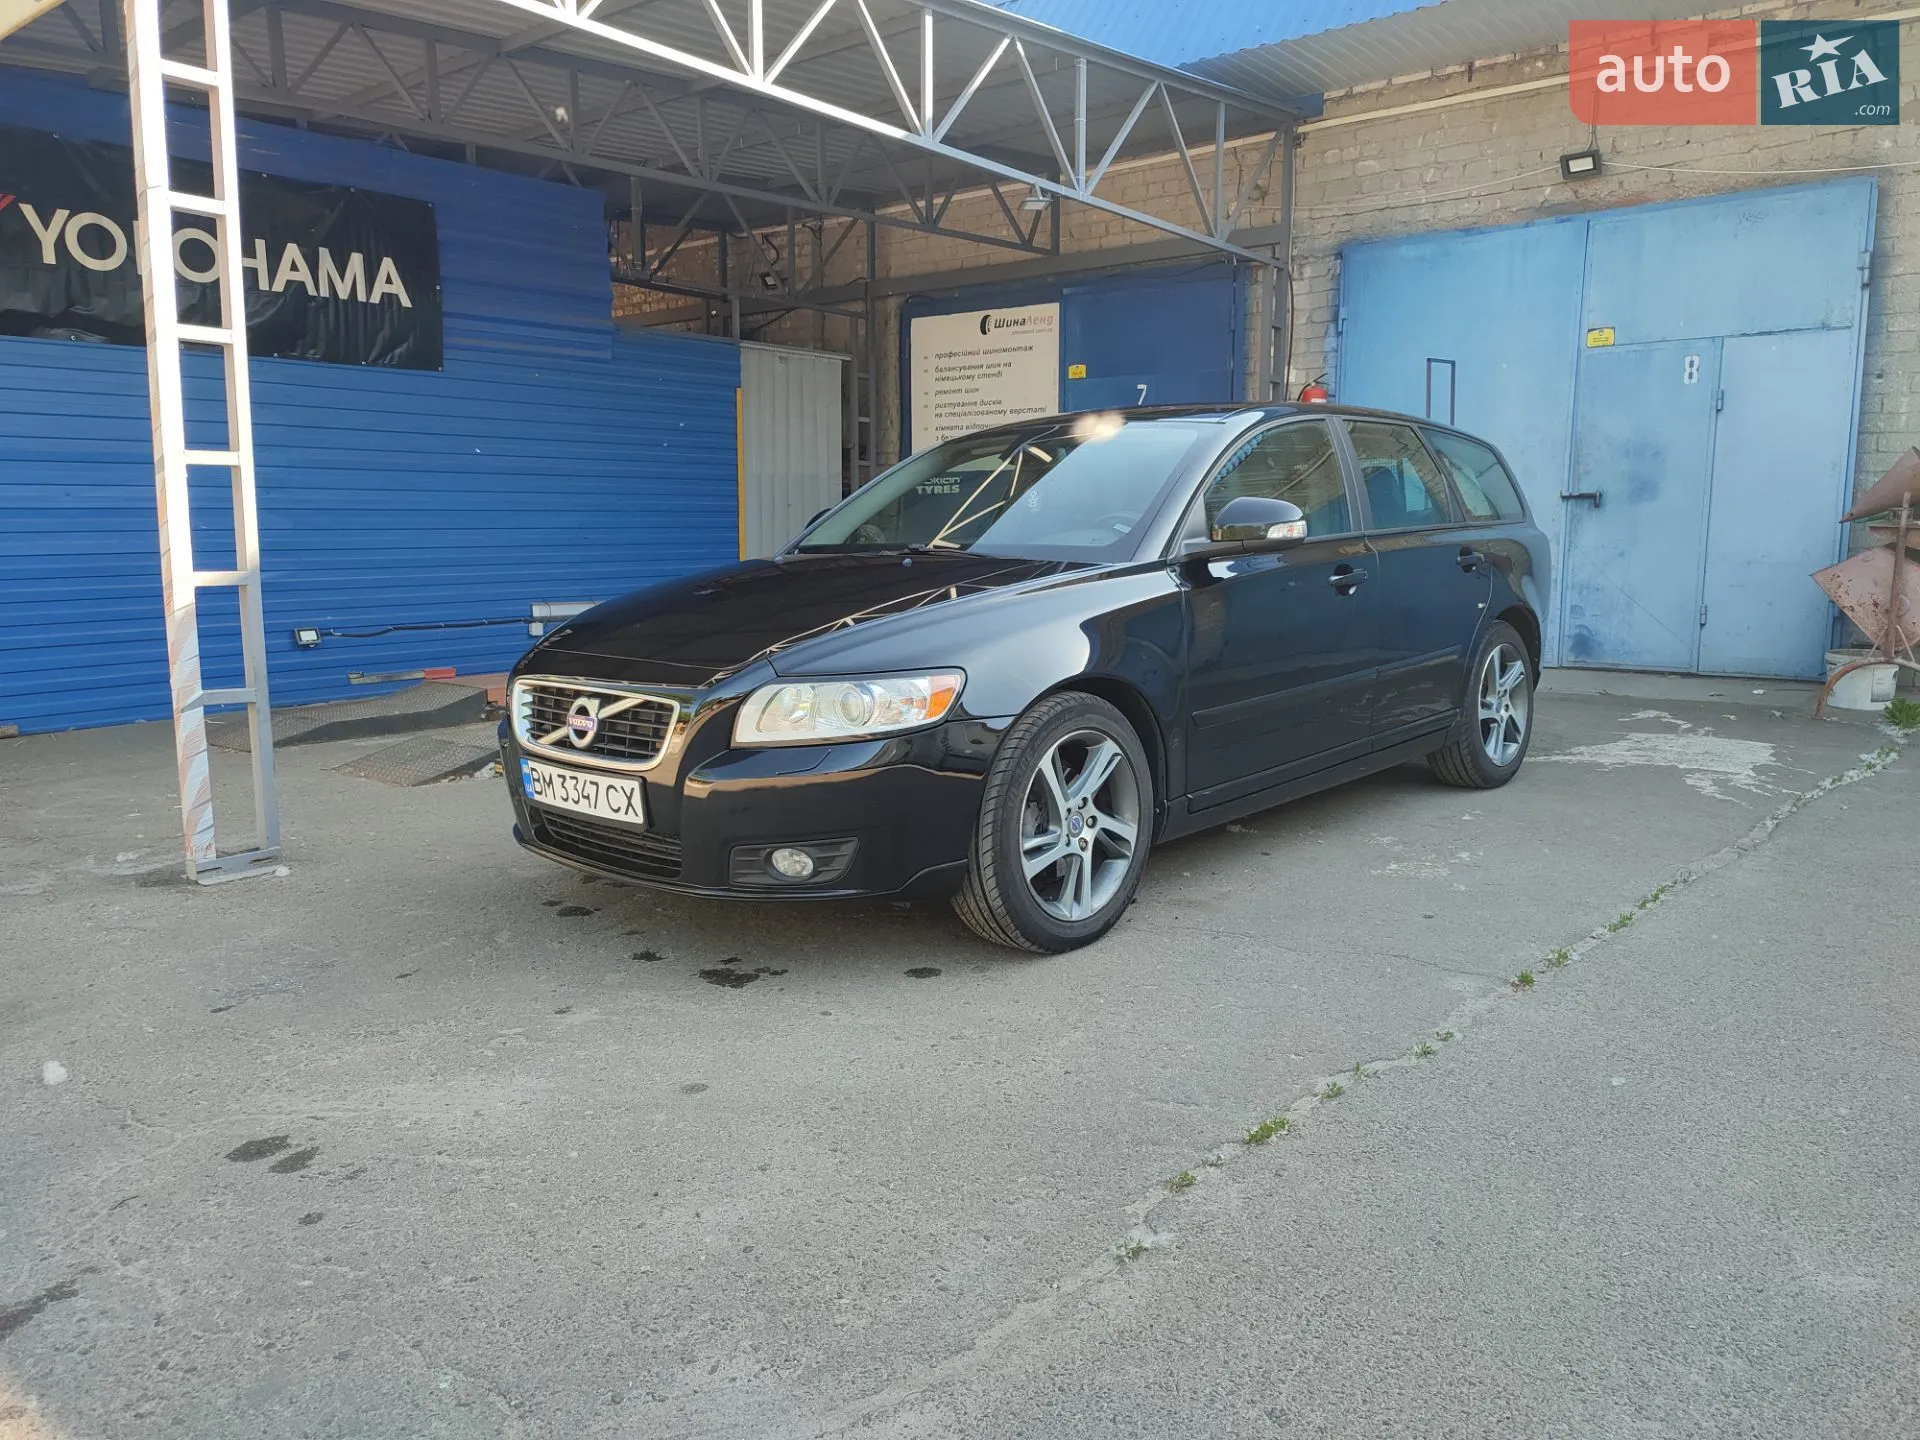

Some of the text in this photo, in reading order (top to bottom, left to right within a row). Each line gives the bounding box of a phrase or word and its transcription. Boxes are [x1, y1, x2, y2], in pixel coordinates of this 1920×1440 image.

[17, 202, 413, 308] YOOHAMA
[934, 345, 1034, 361] професійний шиномонтаж
[934, 361, 1012, 373] балансування шин на
[1683, 355, 1700, 385] 8
[934, 370, 1003, 382] німецькому стенді
[934, 386, 980, 397] ремонт шин
[1136, 384, 1147, 405] 7
[934, 405, 1048, 418] на спеціалізованому верстаті
[915, 485, 960, 495] TYRES
[568, 716, 594, 728] VOLVO
[557, 774, 600, 810] 3347
